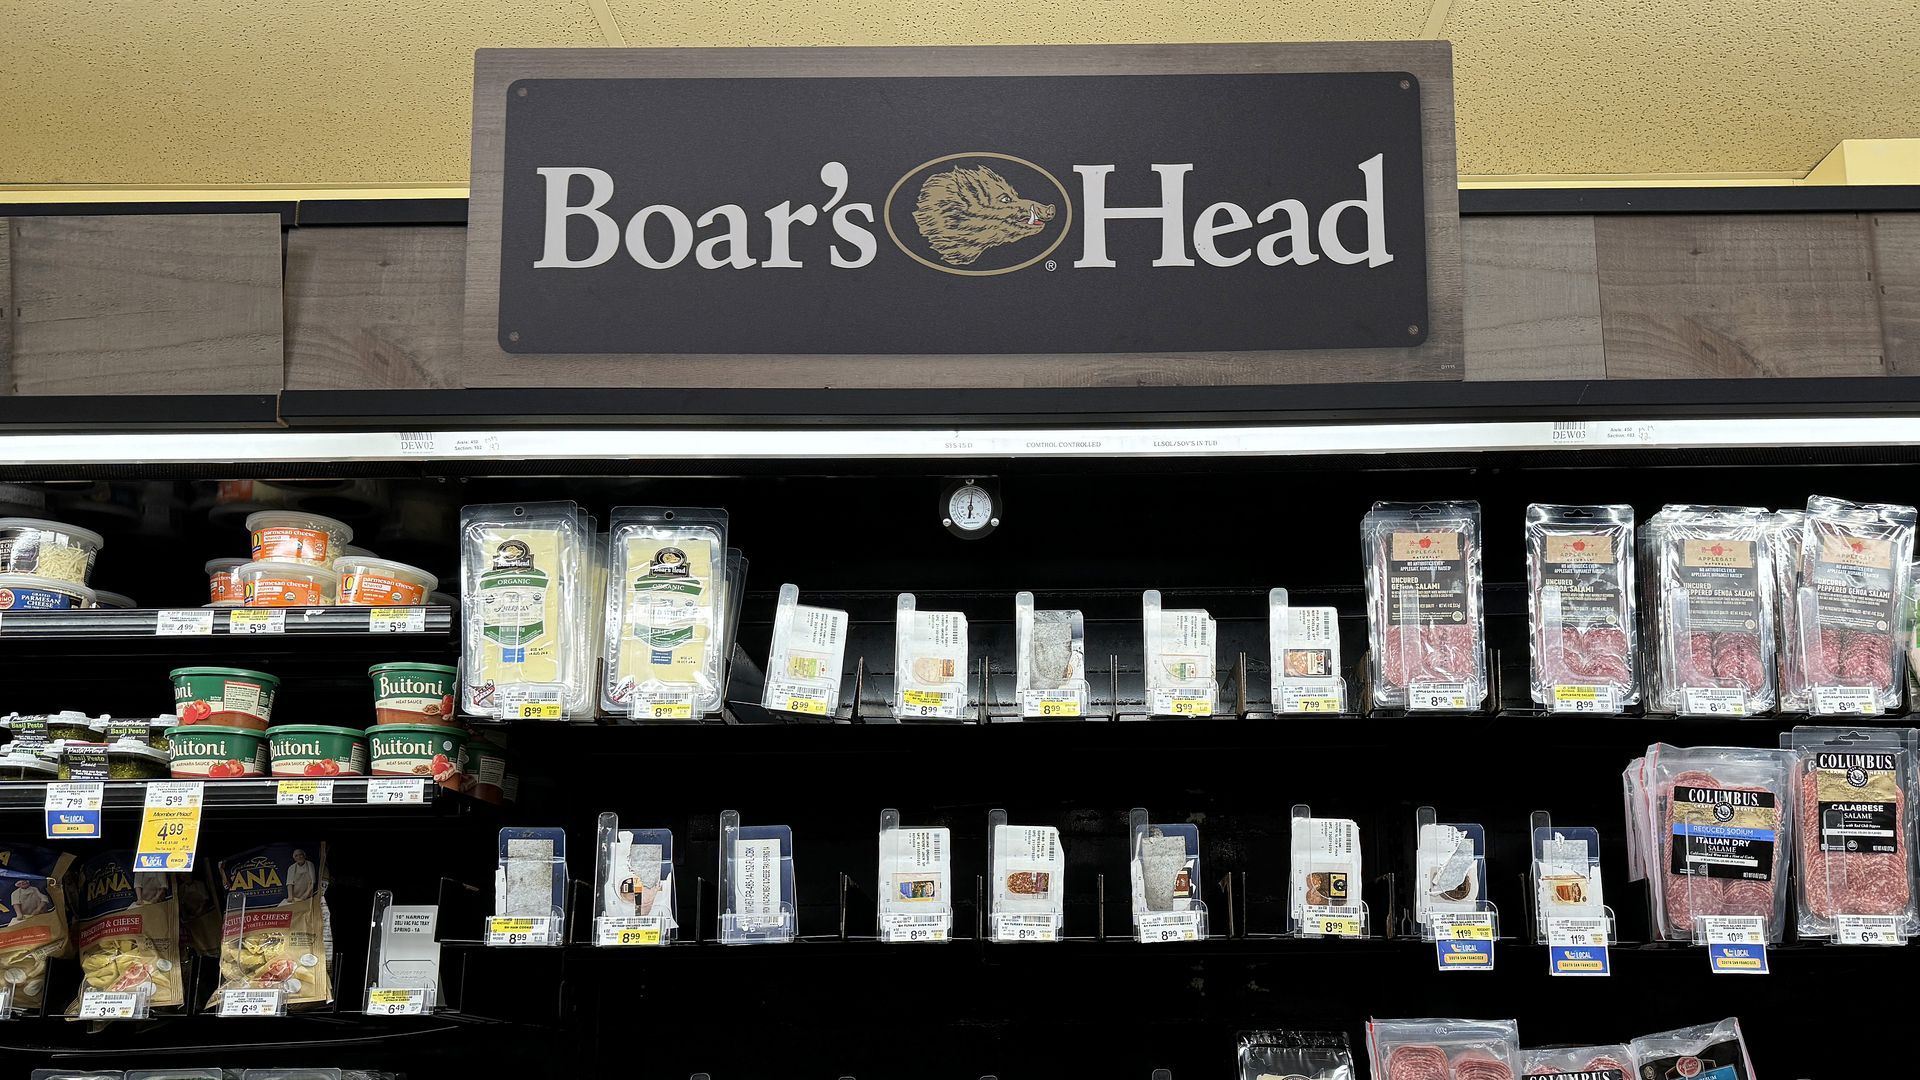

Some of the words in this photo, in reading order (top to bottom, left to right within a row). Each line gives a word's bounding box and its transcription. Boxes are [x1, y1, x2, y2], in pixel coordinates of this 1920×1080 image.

[534, 161, 877, 270] Boar's
[1073, 153, 1393, 269] Head
[1553, 431, 1586, 439] DEW03
[401, 442, 434, 450] DEW02
[1817, 584, 1847, 594] PEPPERED
[1848, 588, 1867, 596] GENOA
[1868, 590, 1890, 599] SALAMI
[21, 594, 60, 605] PARMESAN
[26, 600, 54, 608] CHEESE
[250, 623, 266, 634] 599
[390, 621, 406, 632] 599
[379, 676, 444, 698] Buitoni
[791, 701, 809, 710] 899
[1431, 696, 1448, 706] 899
[1576, 700, 1593, 711] 899
[1839, 701, 1856, 711] 899
[524, 706, 541, 717] 899
[920, 705, 937, 715] 899
[1044, 704, 1060, 715] 899
[1302, 701, 1320, 712] 799
[1710, 702, 1726, 712] 899
[655, 707, 672, 717] 899
[169, 739, 227, 760] Buitoni
[270, 739, 322, 760] Buitoni
[372, 737, 434, 759] Buitoni
[69, 755, 86, 763] Basil
[1820, 753, 1894, 769] COLUMBUS
[165, 795, 183, 806] 599
[297, 794, 314, 804] 599
[387, 792, 404, 801] 799
[1688, 788, 1759, 807] COLUMBUS
[66, 798, 83, 808] 799
[1831, 803, 1884, 812] CALABRESE
[157, 823, 183, 841] 499
[1693, 826, 1725, 835] REDUCED
[1726, 828, 1753, 836] SODIUM
[1695, 836, 1730, 846] ITALIAN
[1732, 838, 1750, 847] DRY
[1708, 845, 1737, 853] SALAME
[230, 868, 282, 891] ANA
[87, 873, 132, 900] RANA
[261, 912, 290, 921] CHEESE
[112, 917, 140, 927] CHEESE
[1325, 922, 1342, 933] 899
[509, 933, 527, 944] 899
[622, 932, 640, 943] 899
[910, 930, 927, 940] 899
[1019, 929, 1035, 939] 899
[1161, 930, 1177, 941] 899
[1455, 929, 1472, 939] 1199
[1727, 932, 1743, 943] 1099
[1861, 932, 1879, 943] 699
[1570, 934, 1585, 945] 1199
[1462, 944, 1477, 952] LOCAL
[1733, 948, 1750, 957] LOCAL
[1576, 951, 1592, 959] LOCAL
[98, 1007, 115, 1017] 349
[241, 1004, 257, 1014] 649
[388, 1004, 405, 1014] 649
